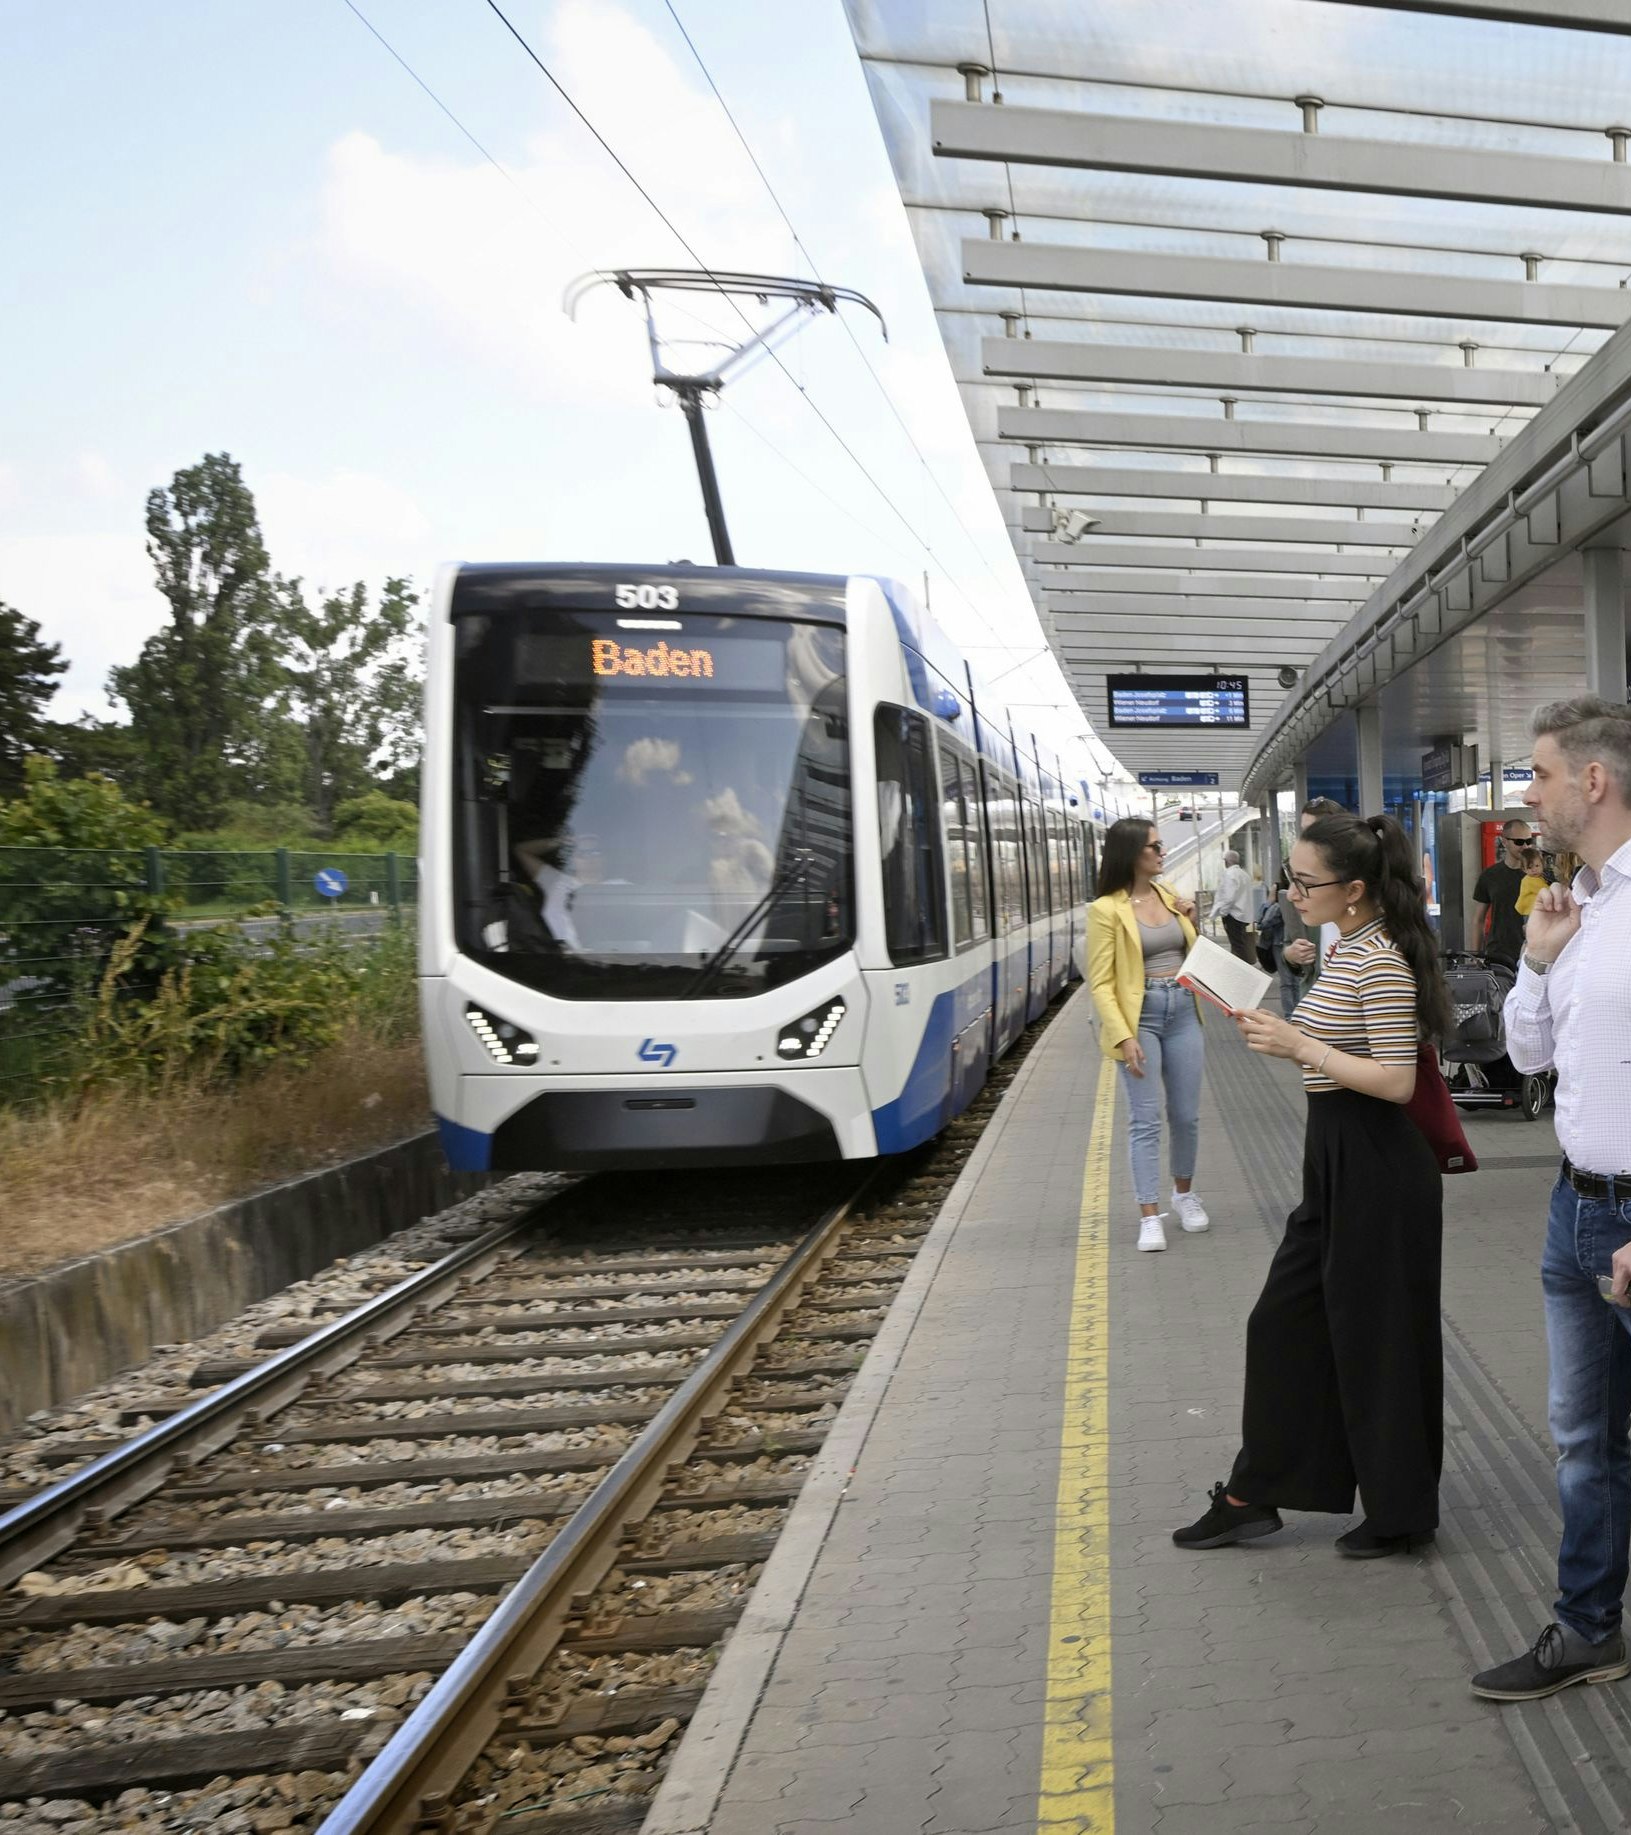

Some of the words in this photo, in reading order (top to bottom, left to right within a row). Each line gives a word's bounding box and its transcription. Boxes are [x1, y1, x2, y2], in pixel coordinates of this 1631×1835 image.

[615, 583, 679, 610] 503
[592, 639, 713, 677] Baden
[1216, 680, 1243, 690] 10:45
